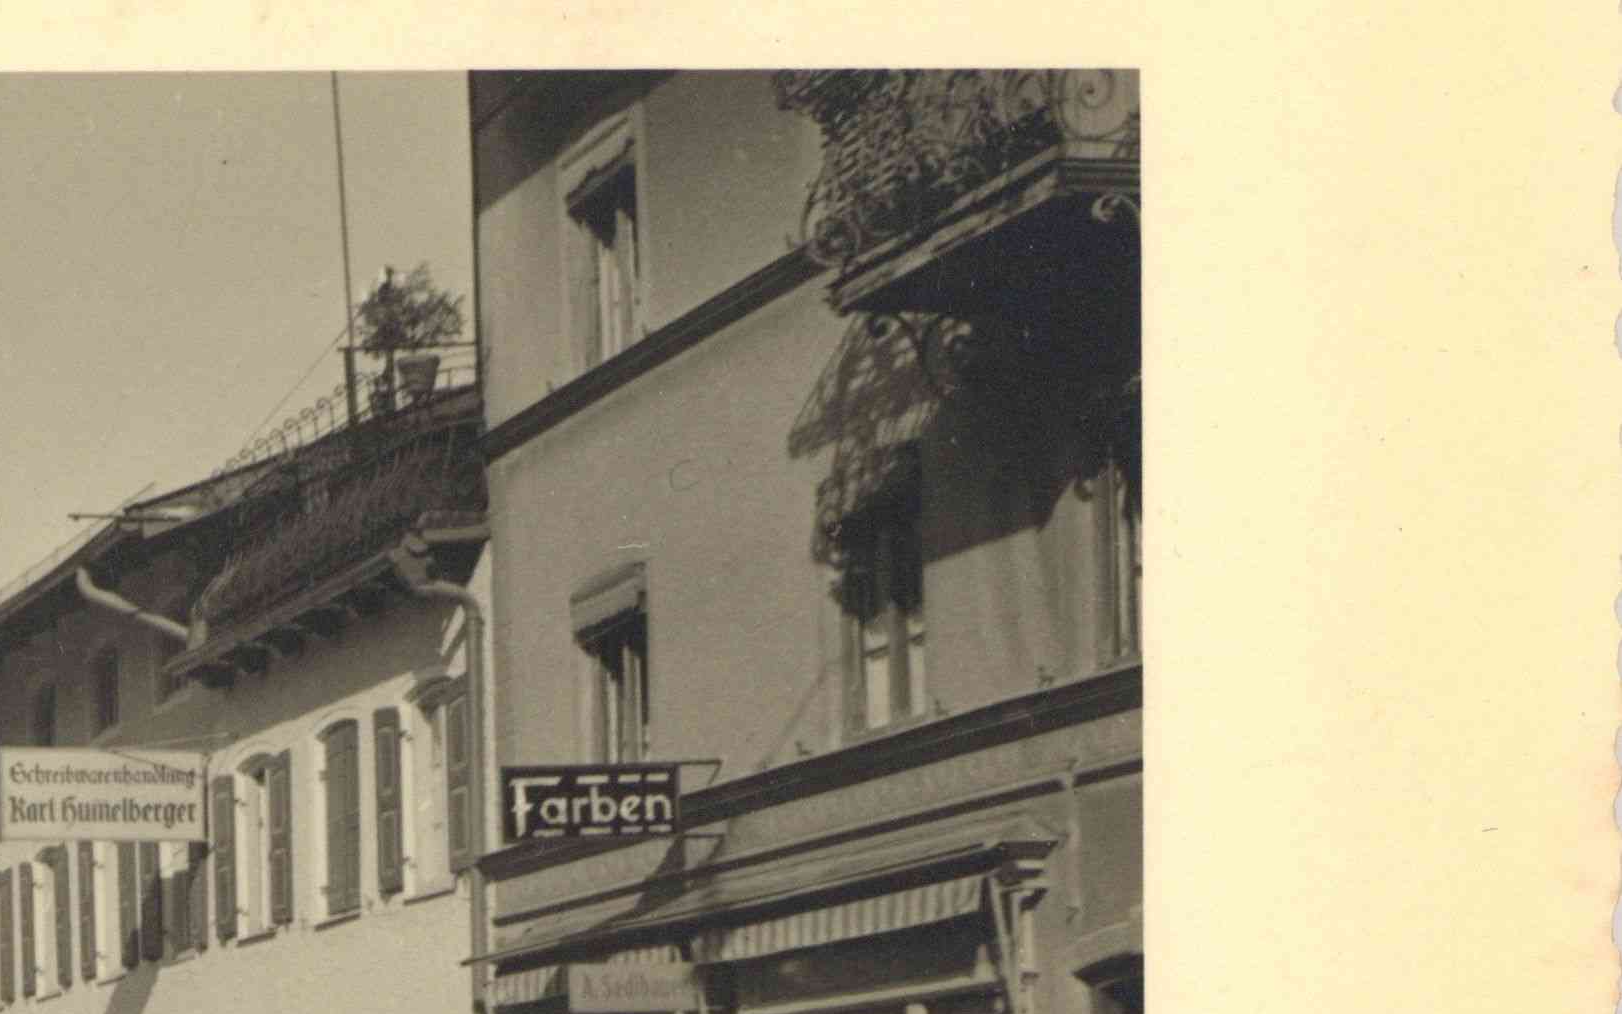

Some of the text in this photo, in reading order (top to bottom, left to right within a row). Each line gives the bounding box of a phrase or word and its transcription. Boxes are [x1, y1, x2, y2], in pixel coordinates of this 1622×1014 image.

[9, 762, 195, 790] Schreibwarenhandlung
[9, 796, 56, 823] Karl
[509, 776, 674, 837] Farben
